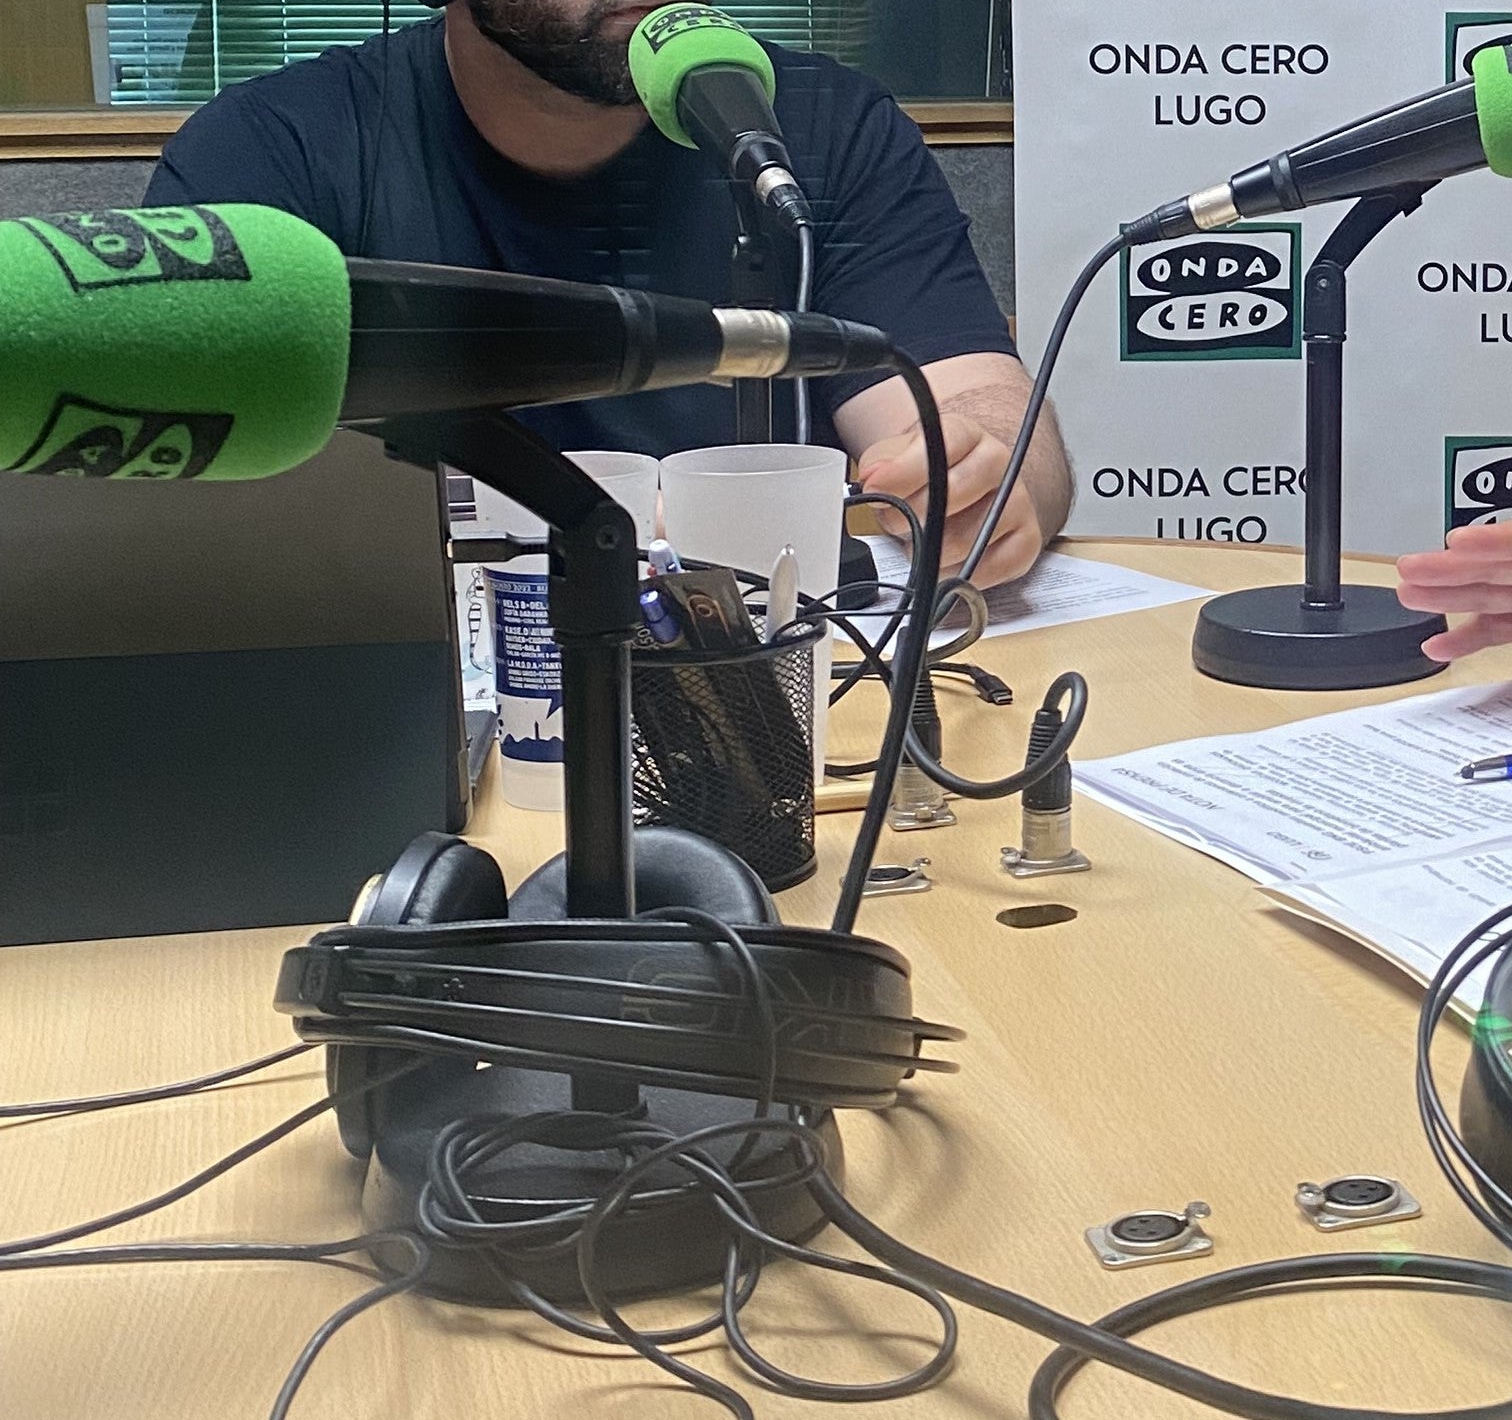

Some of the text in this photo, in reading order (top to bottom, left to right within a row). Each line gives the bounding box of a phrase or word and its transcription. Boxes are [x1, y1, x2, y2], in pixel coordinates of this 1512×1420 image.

[1089, 43, 1329, 75] ONDA CERO
[1155, 94, 1266, 126] LUGO
[1150, 257, 1268, 283] ONDA
[1157, 305, 1268, 330] CERO
[1092, 467, 1211, 498] ONDA
